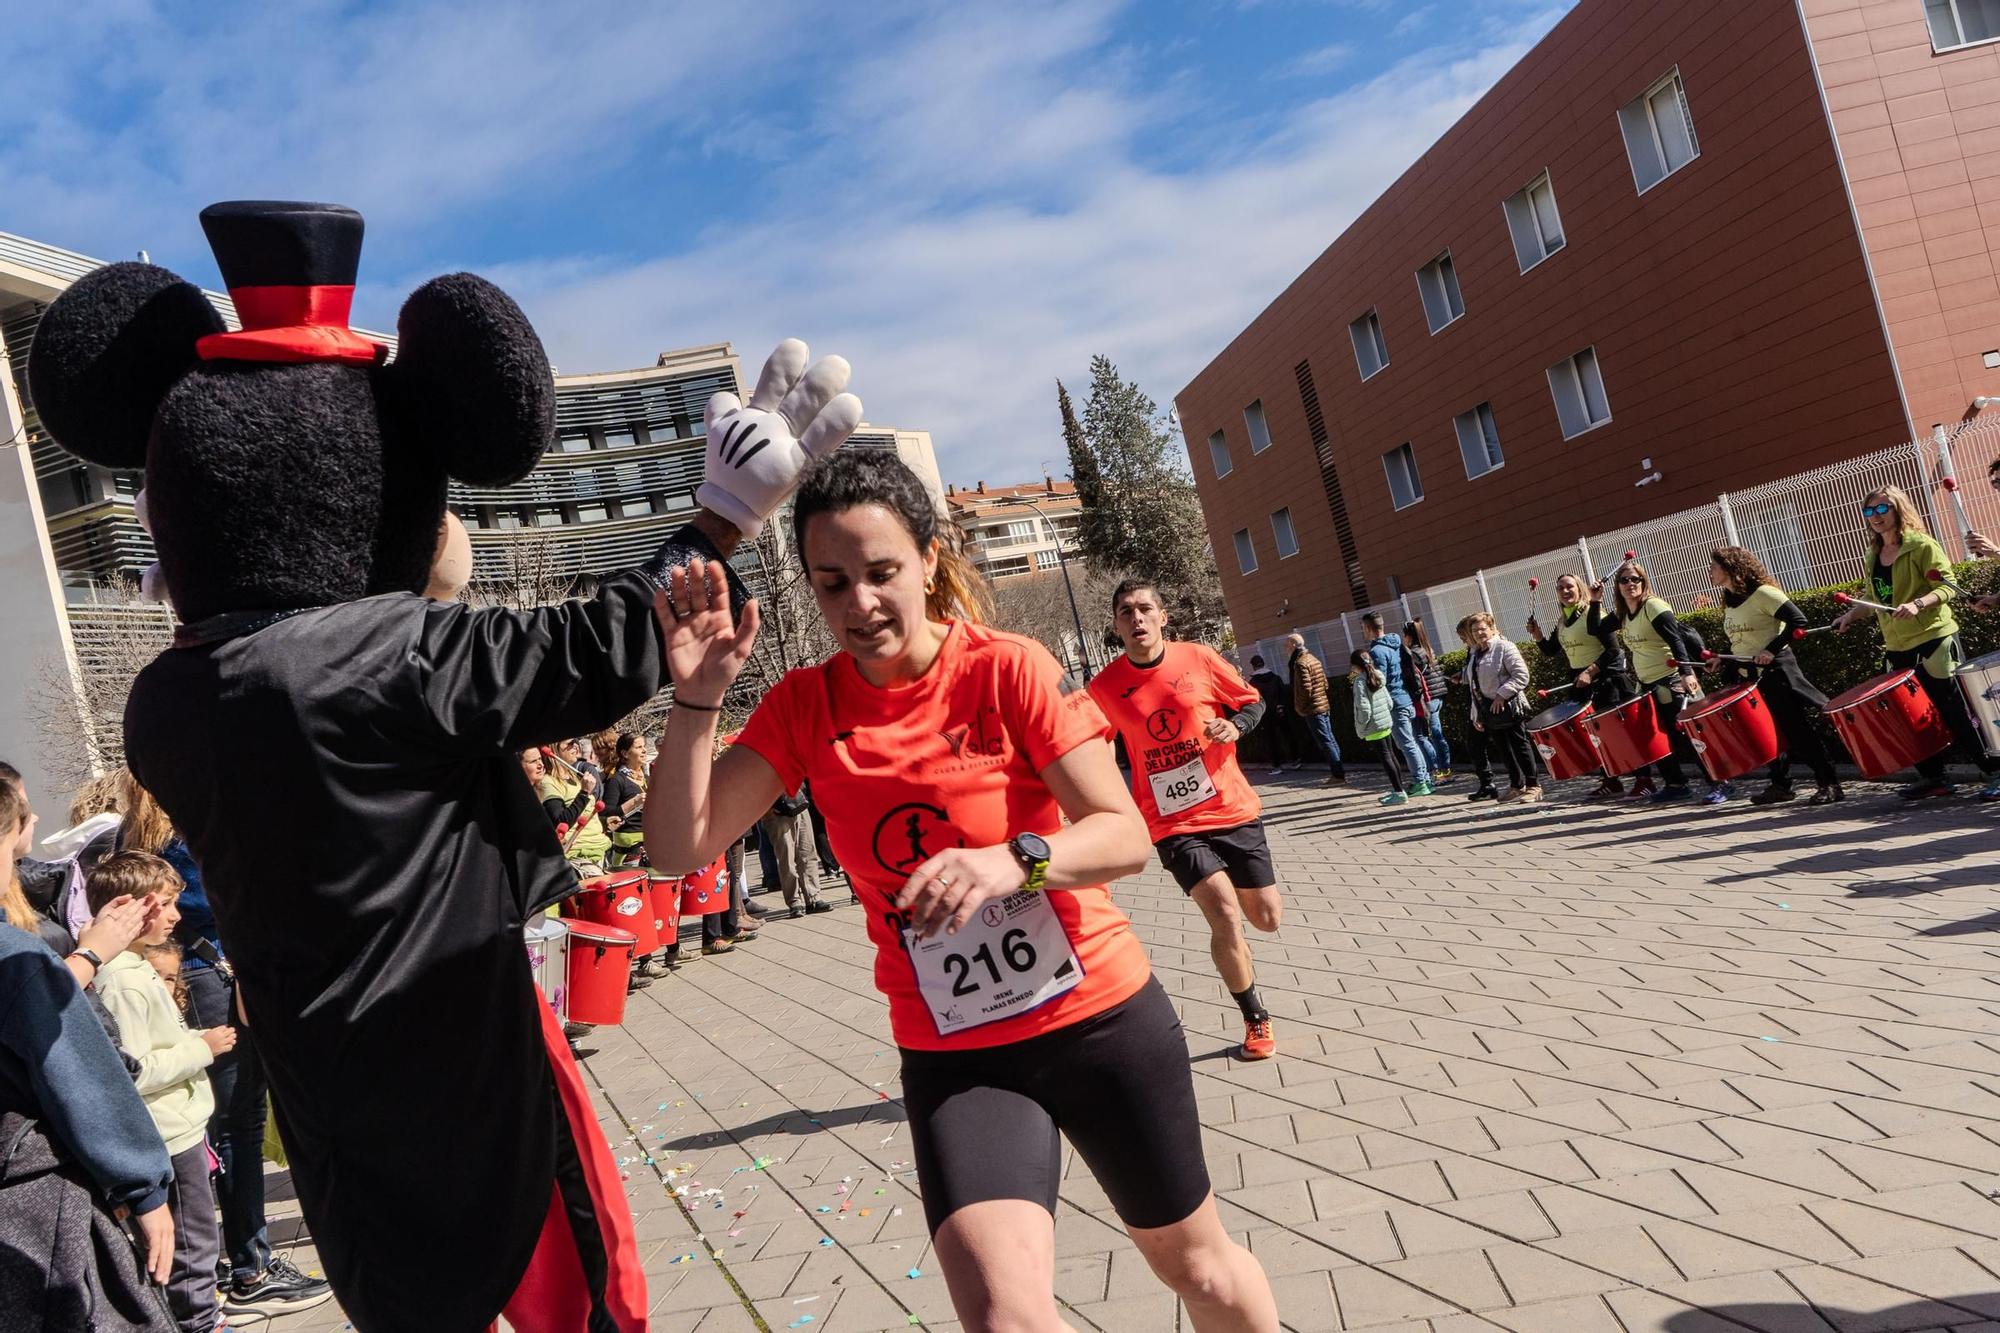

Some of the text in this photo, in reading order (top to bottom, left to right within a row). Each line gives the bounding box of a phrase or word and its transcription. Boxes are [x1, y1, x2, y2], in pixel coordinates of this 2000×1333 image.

[1144, 737, 1200, 760] VIII CURSA
[1144, 759, 1159, 771] DE
[1160, 756, 1173, 769] LA
[1174, 747, 1205, 765] DONA
[1165, 775, 1200, 800] 485
[943, 928, 1037, 997] 216
[993, 989, 1014, 1001] IRENE
[981, 1001, 1007, 1013] PLANAS
